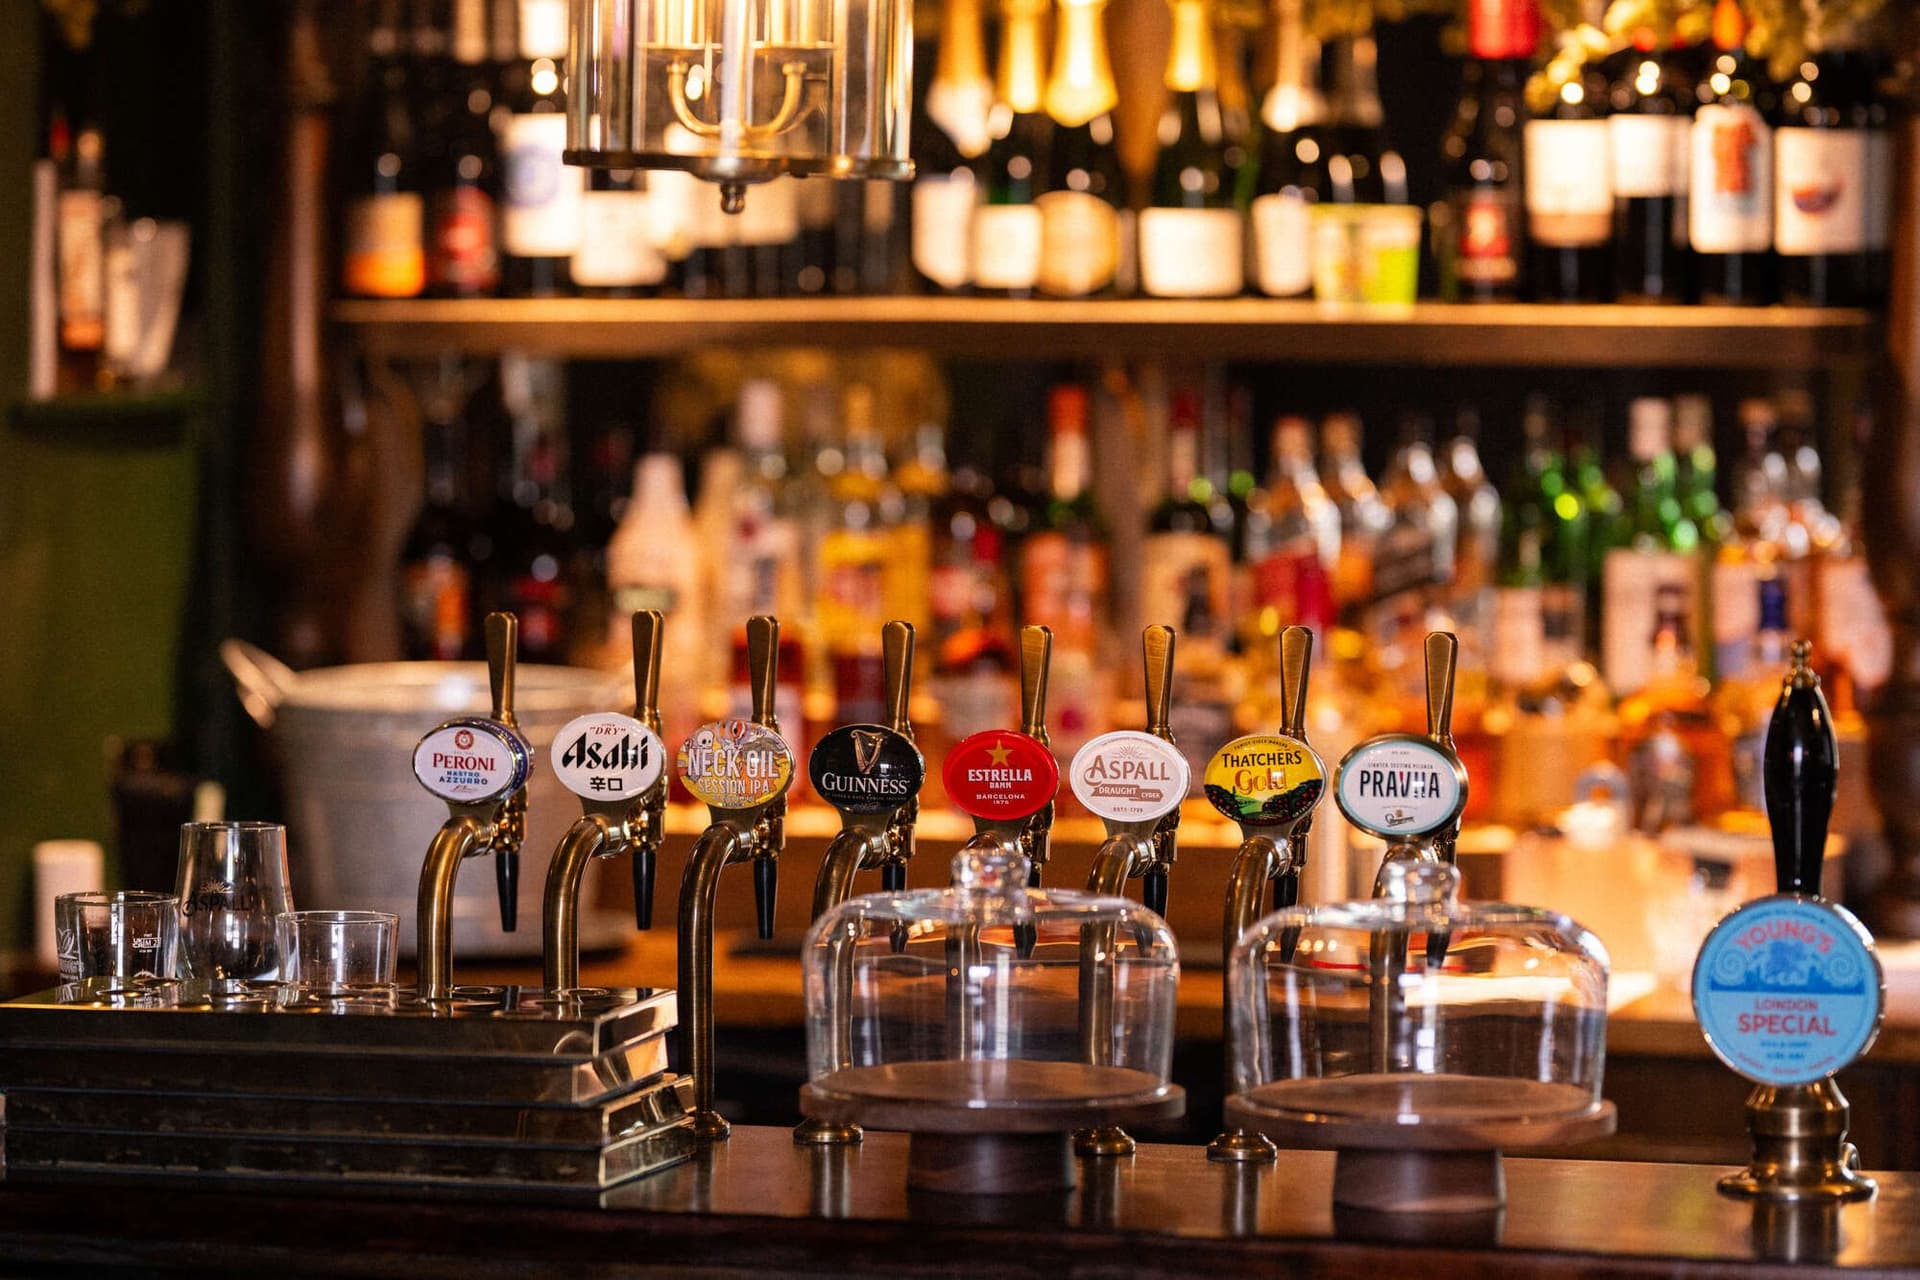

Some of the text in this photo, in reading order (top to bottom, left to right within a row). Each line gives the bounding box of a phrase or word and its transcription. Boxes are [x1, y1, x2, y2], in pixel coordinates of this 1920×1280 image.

[562, 732, 649, 770] Asahi
[1221, 750, 1302, 768] THATCHERS
[432, 752, 496, 771] PERONI
[687, 748, 741, 778] NECK
[1083, 754, 1171, 786] ASPALL
[439, 776, 488, 785] AZZURRO
[590, 776, 623, 791] 辛口
[822, 772, 908, 795] GUINNESS
[968, 768, 1033, 782] ESTRELLA
[1235, 767, 1287, 795] Gold
[1360, 770, 1440, 798] PRAVHA
[697, 778, 770, 794] SESSION IPA
[1099, 786, 1137, 795] DRAUGHT
[1141, 791, 1161, 799] CYDER
[1735, 919, 1836, 954] YOUNG'S
[1754, 998, 1818, 1012] LONDON
[1737, 1013, 1837, 1036] SPECIAL
